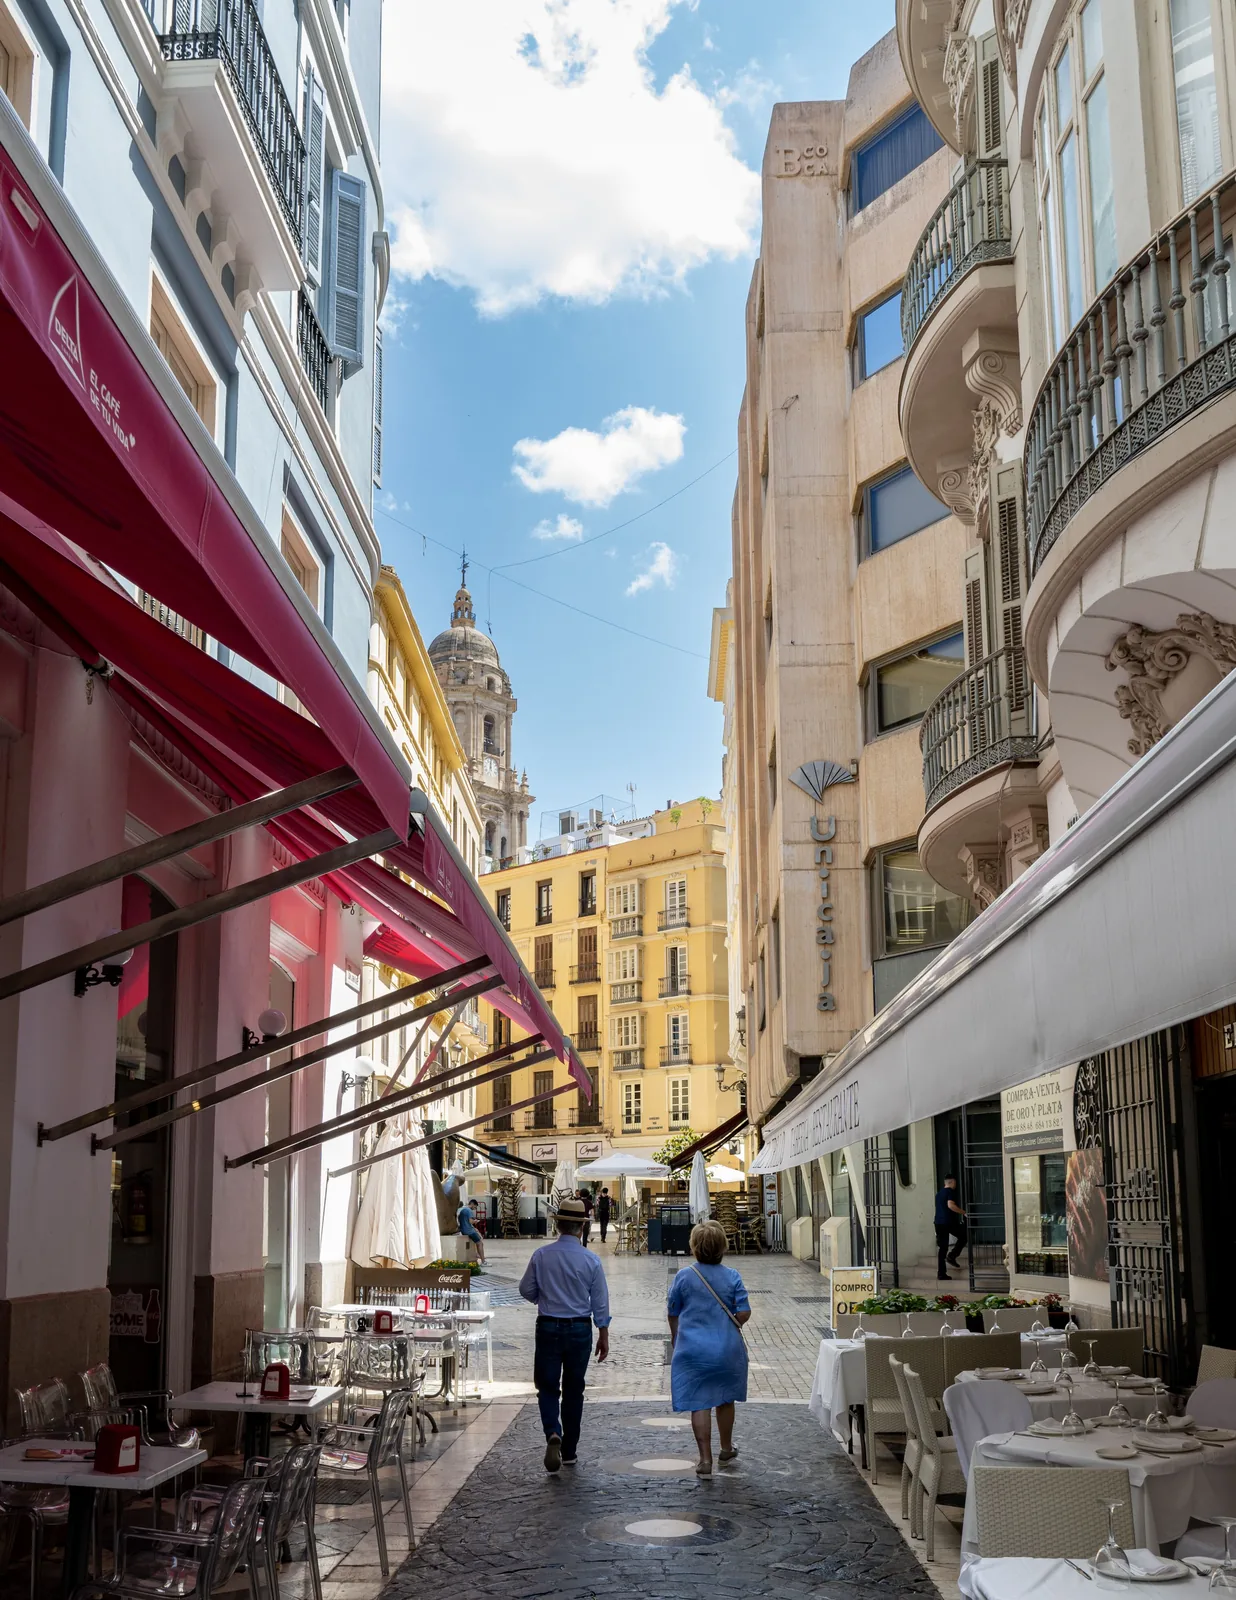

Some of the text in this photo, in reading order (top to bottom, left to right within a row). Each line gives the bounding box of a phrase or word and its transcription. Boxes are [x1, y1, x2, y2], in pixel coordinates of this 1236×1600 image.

[55, 316, 79, 363] DELTA
[90, 368, 121, 419] EL CAFÉ
[90, 387, 130, 452] DE TU VIDA
[810, 815, 836, 1012] Unicaja
[1006, 1082, 1061, 1104] COMPRA-VENTA
[1006, 1110, 1015, 1122] DE
[1016, 1107, 1030, 1120] ORO
[1038, 1101, 1063, 1117] PLATA
[438, 1274, 463, 1284] Coca-Cola
[834, 1283, 874, 1292] COMPRO
